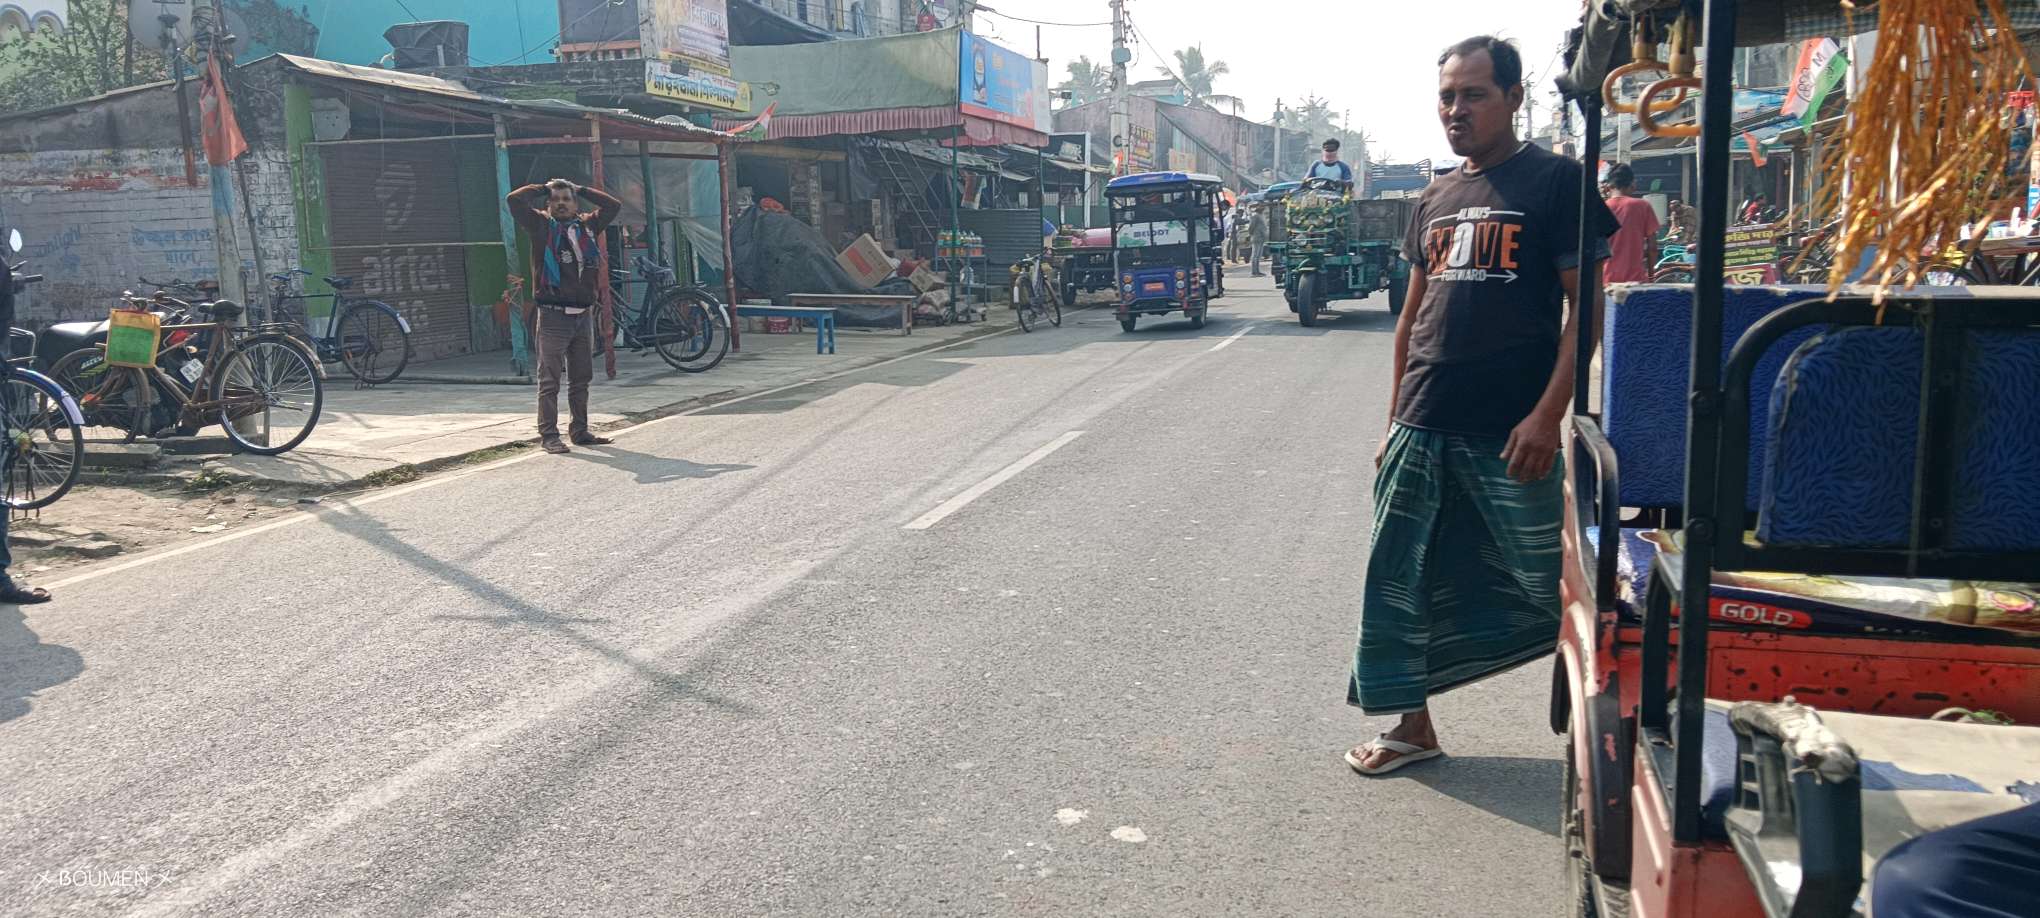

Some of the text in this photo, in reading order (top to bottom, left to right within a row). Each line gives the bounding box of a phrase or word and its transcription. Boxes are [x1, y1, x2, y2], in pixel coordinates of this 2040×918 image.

[1457, 207, 1491, 221] ALWAYS
[1427, 222, 1522, 274] MOVE
[362, 247, 451, 294] airtel
[1441, 269, 1487, 281] FORWARD
[1720, 603, 1793, 626] GOLD
